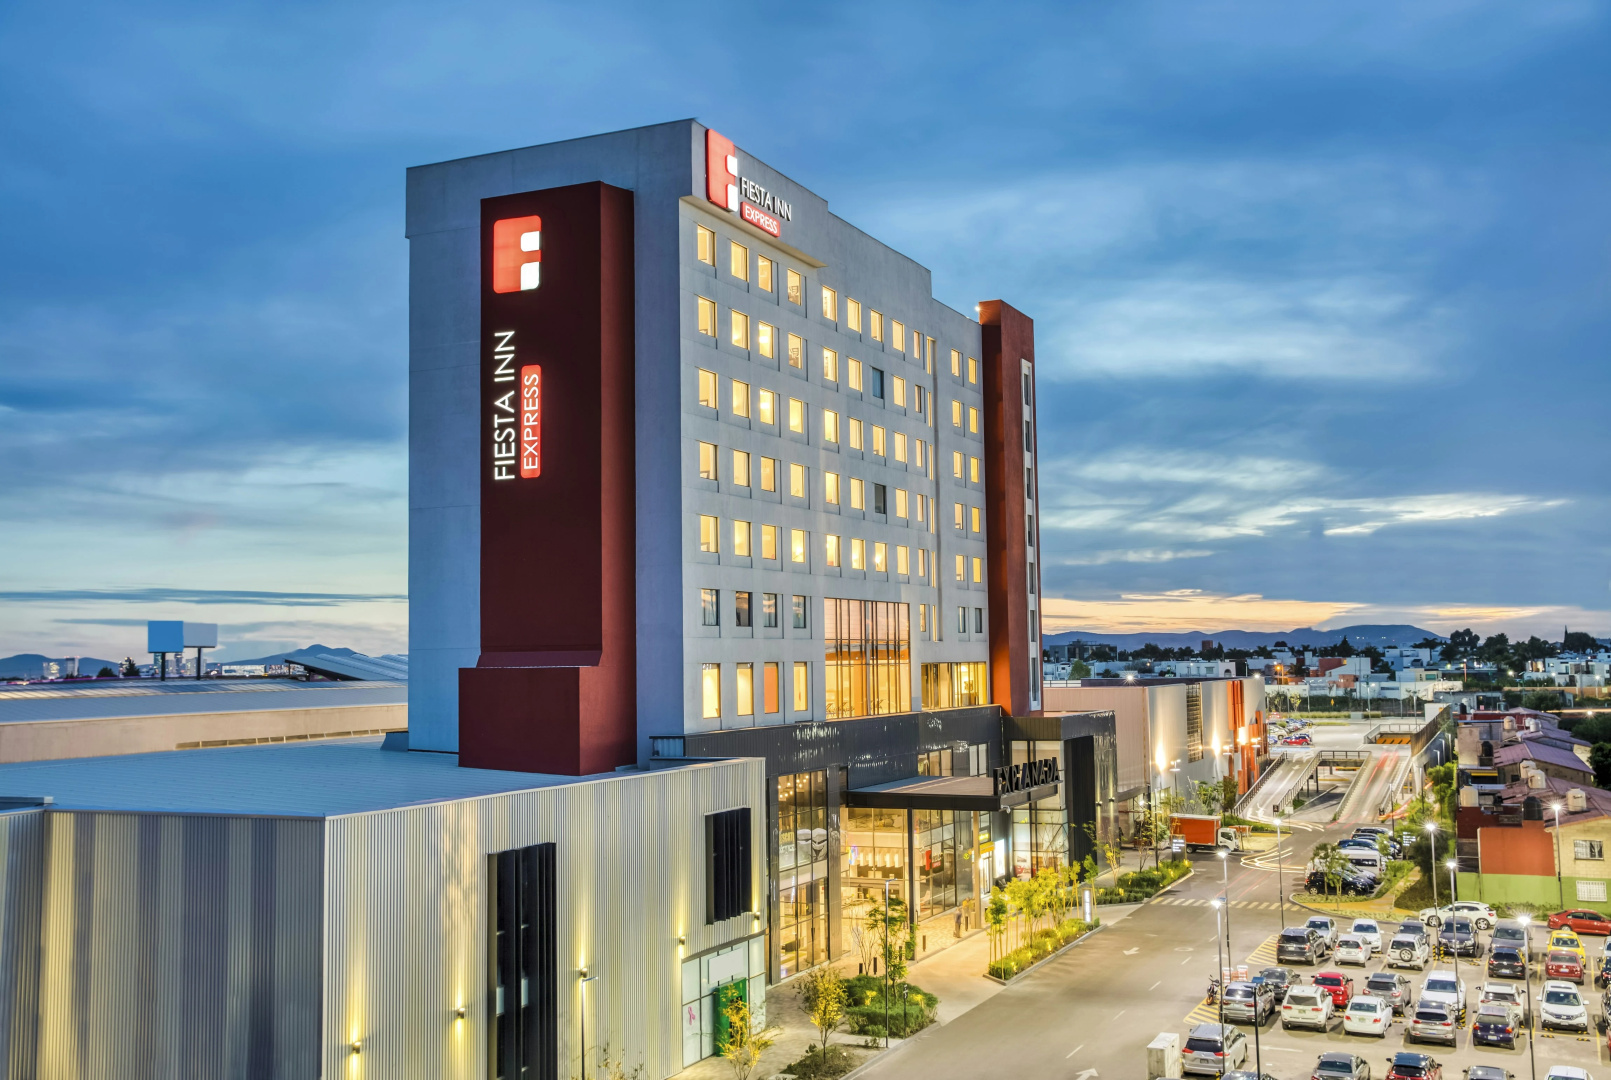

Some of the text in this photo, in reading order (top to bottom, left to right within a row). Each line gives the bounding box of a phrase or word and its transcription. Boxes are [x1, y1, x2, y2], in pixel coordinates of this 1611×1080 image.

[740, 177, 792, 221] FIESTA INN
[745, 206, 778, 234] EXPRESS
[494, 330, 515, 480] FIESTA INN
[523, 373, 539, 470] EXPRESS
